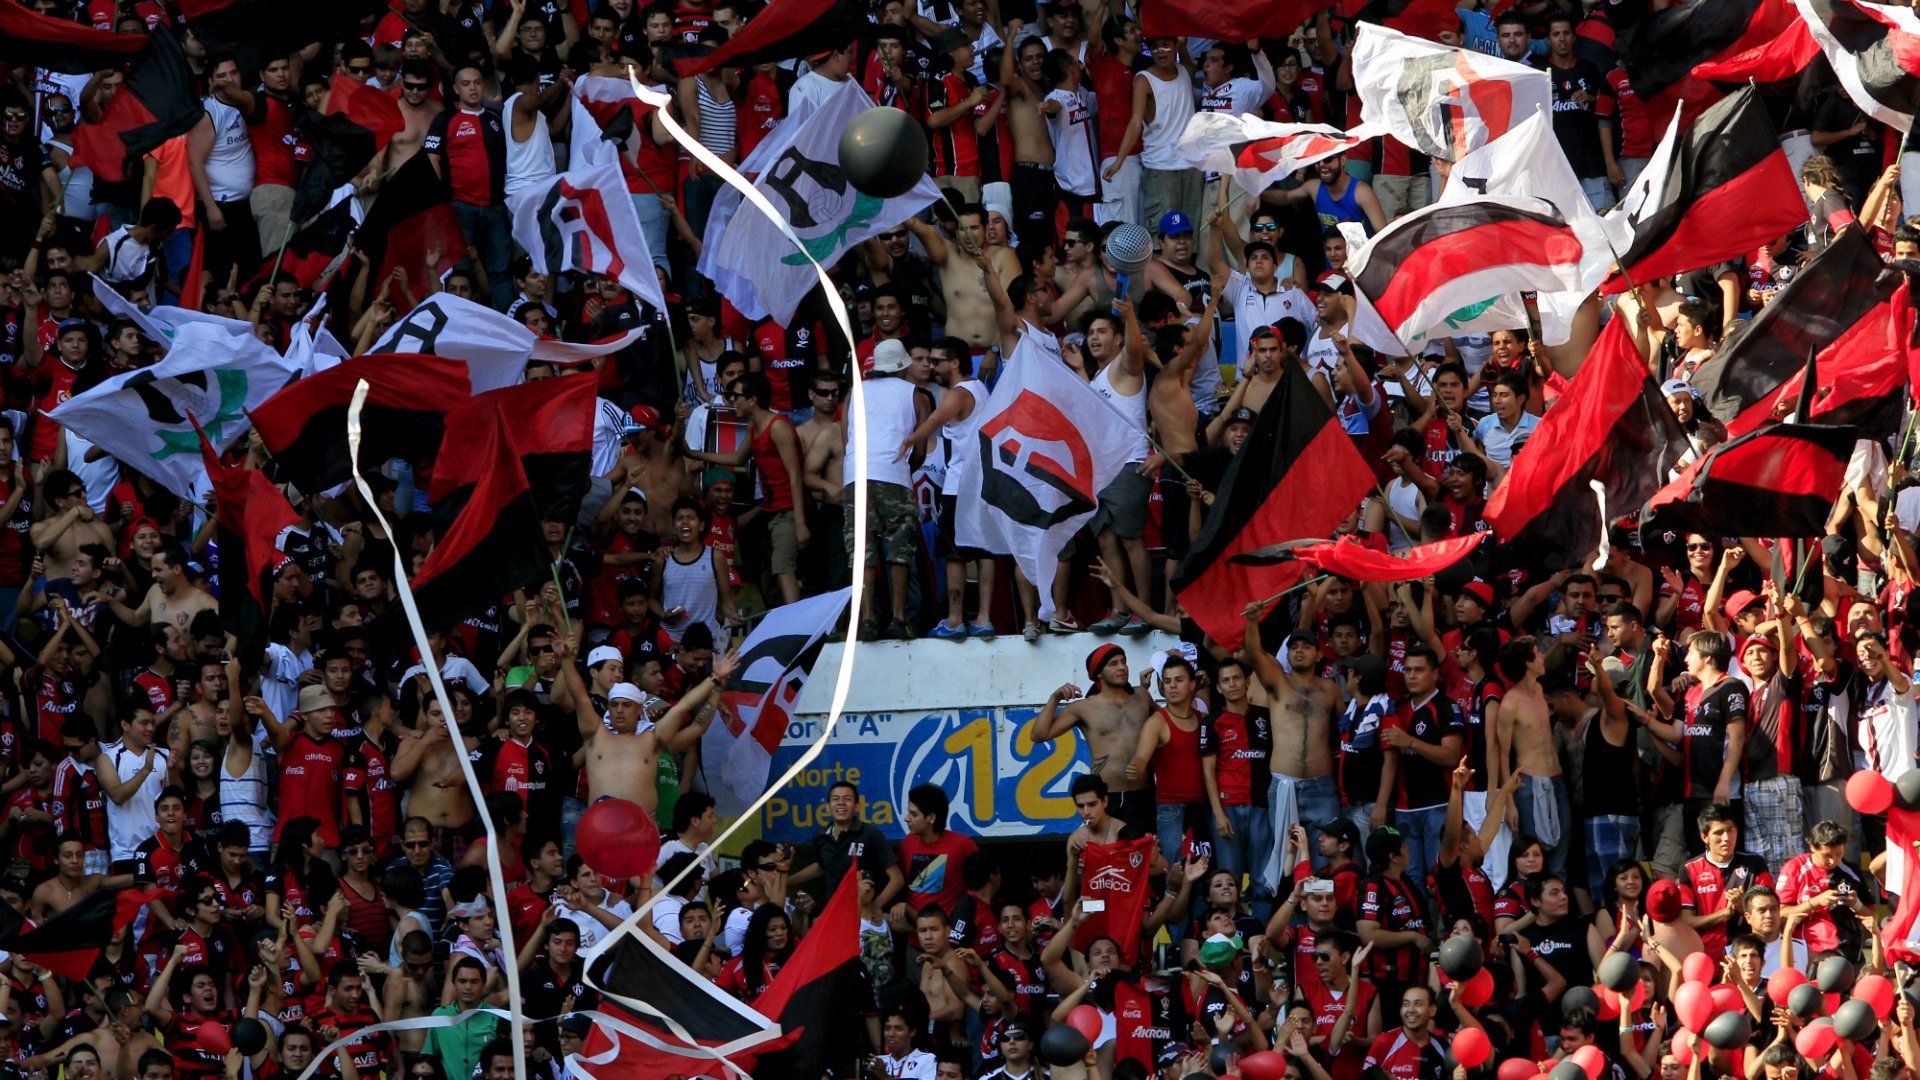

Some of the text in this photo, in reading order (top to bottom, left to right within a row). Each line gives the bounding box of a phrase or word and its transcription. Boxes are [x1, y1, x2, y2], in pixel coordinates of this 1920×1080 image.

[426, 142, 441, 150] SKY
[845, 713, 892, 737] "A"
[1684, 725, 1712, 736] KRON
[1231, 749, 1267, 760] AKRON
[787, 761, 861, 789] Norte
[765, 795, 894, 830] Pueta
[1362, 903, 1381, 911] SKY
[1207, 1002, 1224, 1012] SKY
[1131, 1025, 1171, 1039] AKRON
